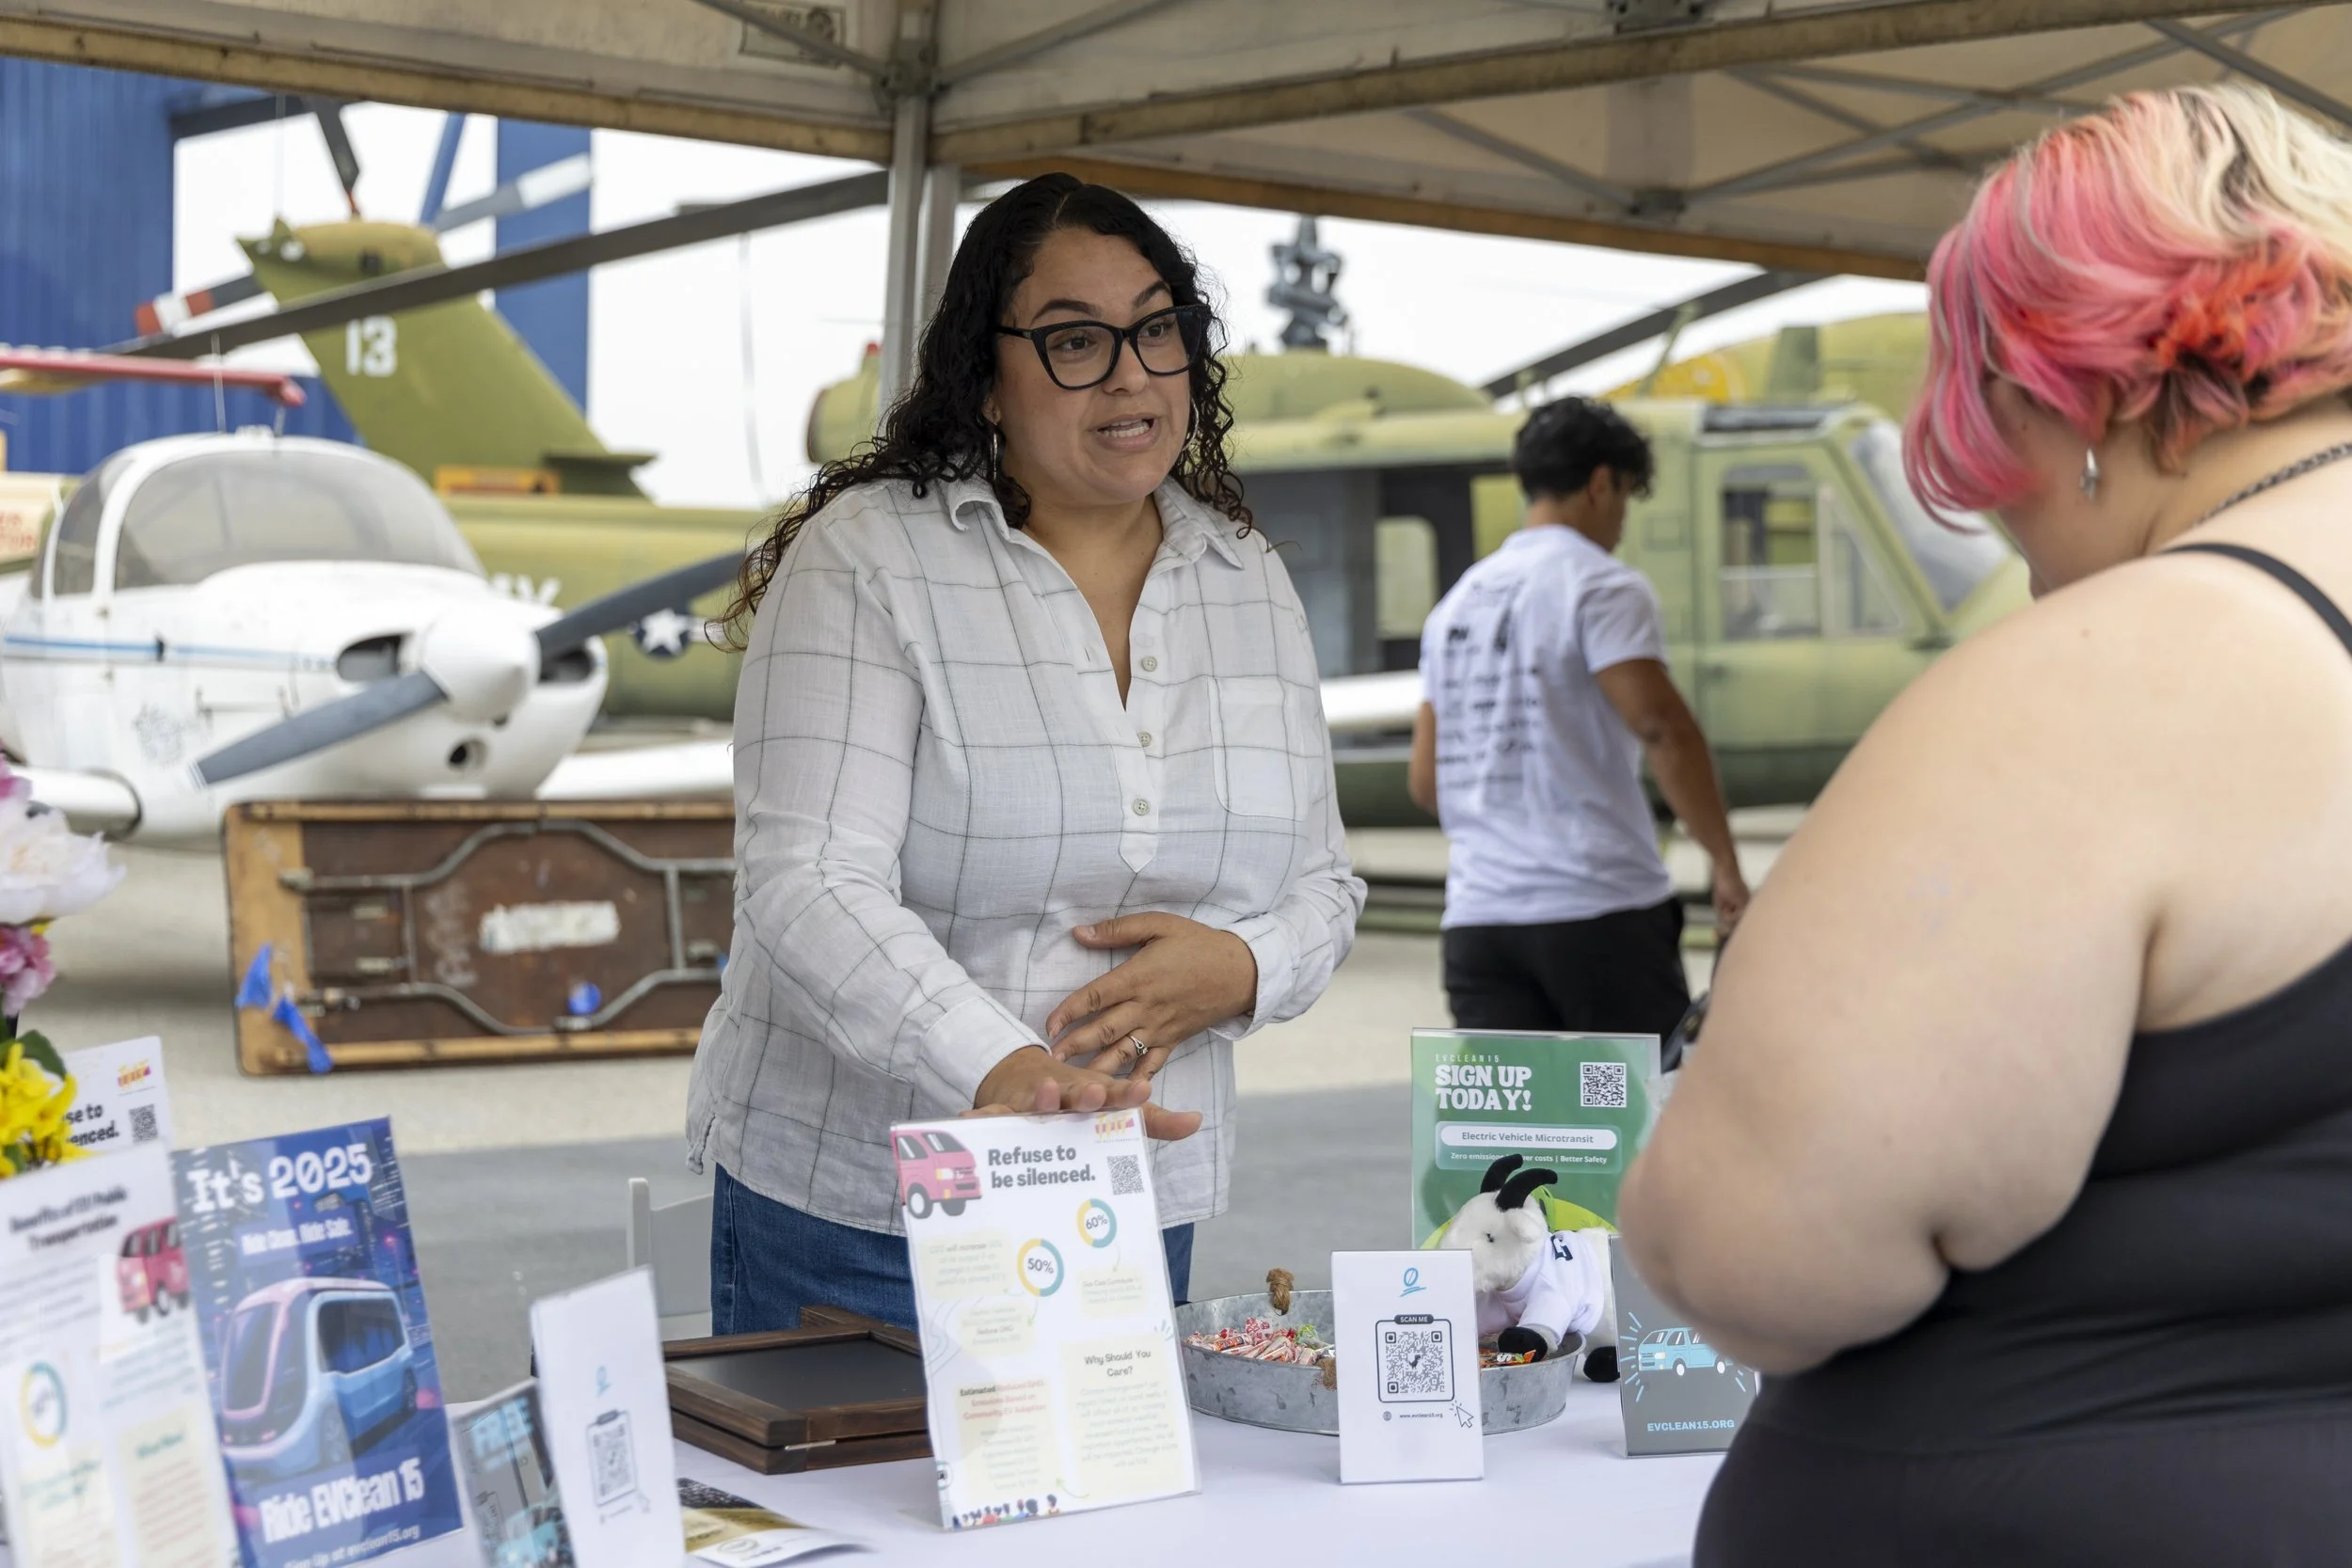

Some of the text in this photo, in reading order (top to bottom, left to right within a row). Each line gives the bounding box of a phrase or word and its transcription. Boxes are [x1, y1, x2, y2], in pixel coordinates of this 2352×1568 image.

[345, 314, 398, 377] 13
[1435, 1053, 1500, 1063] EVCLEAN15
[1435, 1065, 1533, 1087] SIGN UP
[1435, 1087, 1533, 1112] TODAY!
[67, 1119, 119, 1146] enced.
[1461, 1132, 1595, 1144] Electric Vehicle Microtransit
[988, 1145, 1076, 1166] Refuse to
[1584, 1156, 1607, 1164] Safety
[186, 1143, 373, 1213] It's 2025
[992, 1164, 1096, 1189] be silenced.
[1085, 1215, 1108, 1229] 60%
[1027, 1258, 1055, 1274] 50%
[1085, 1349, 1152, 1366] Why Should You
[1106, 1366, 1134, 1377] Care?
[1646, 1419, 1735, 1432] EVCLEAN15.ORG
[259, 1492, 313, 1544] Ride
[399, 1457, 425, 1502] 15
